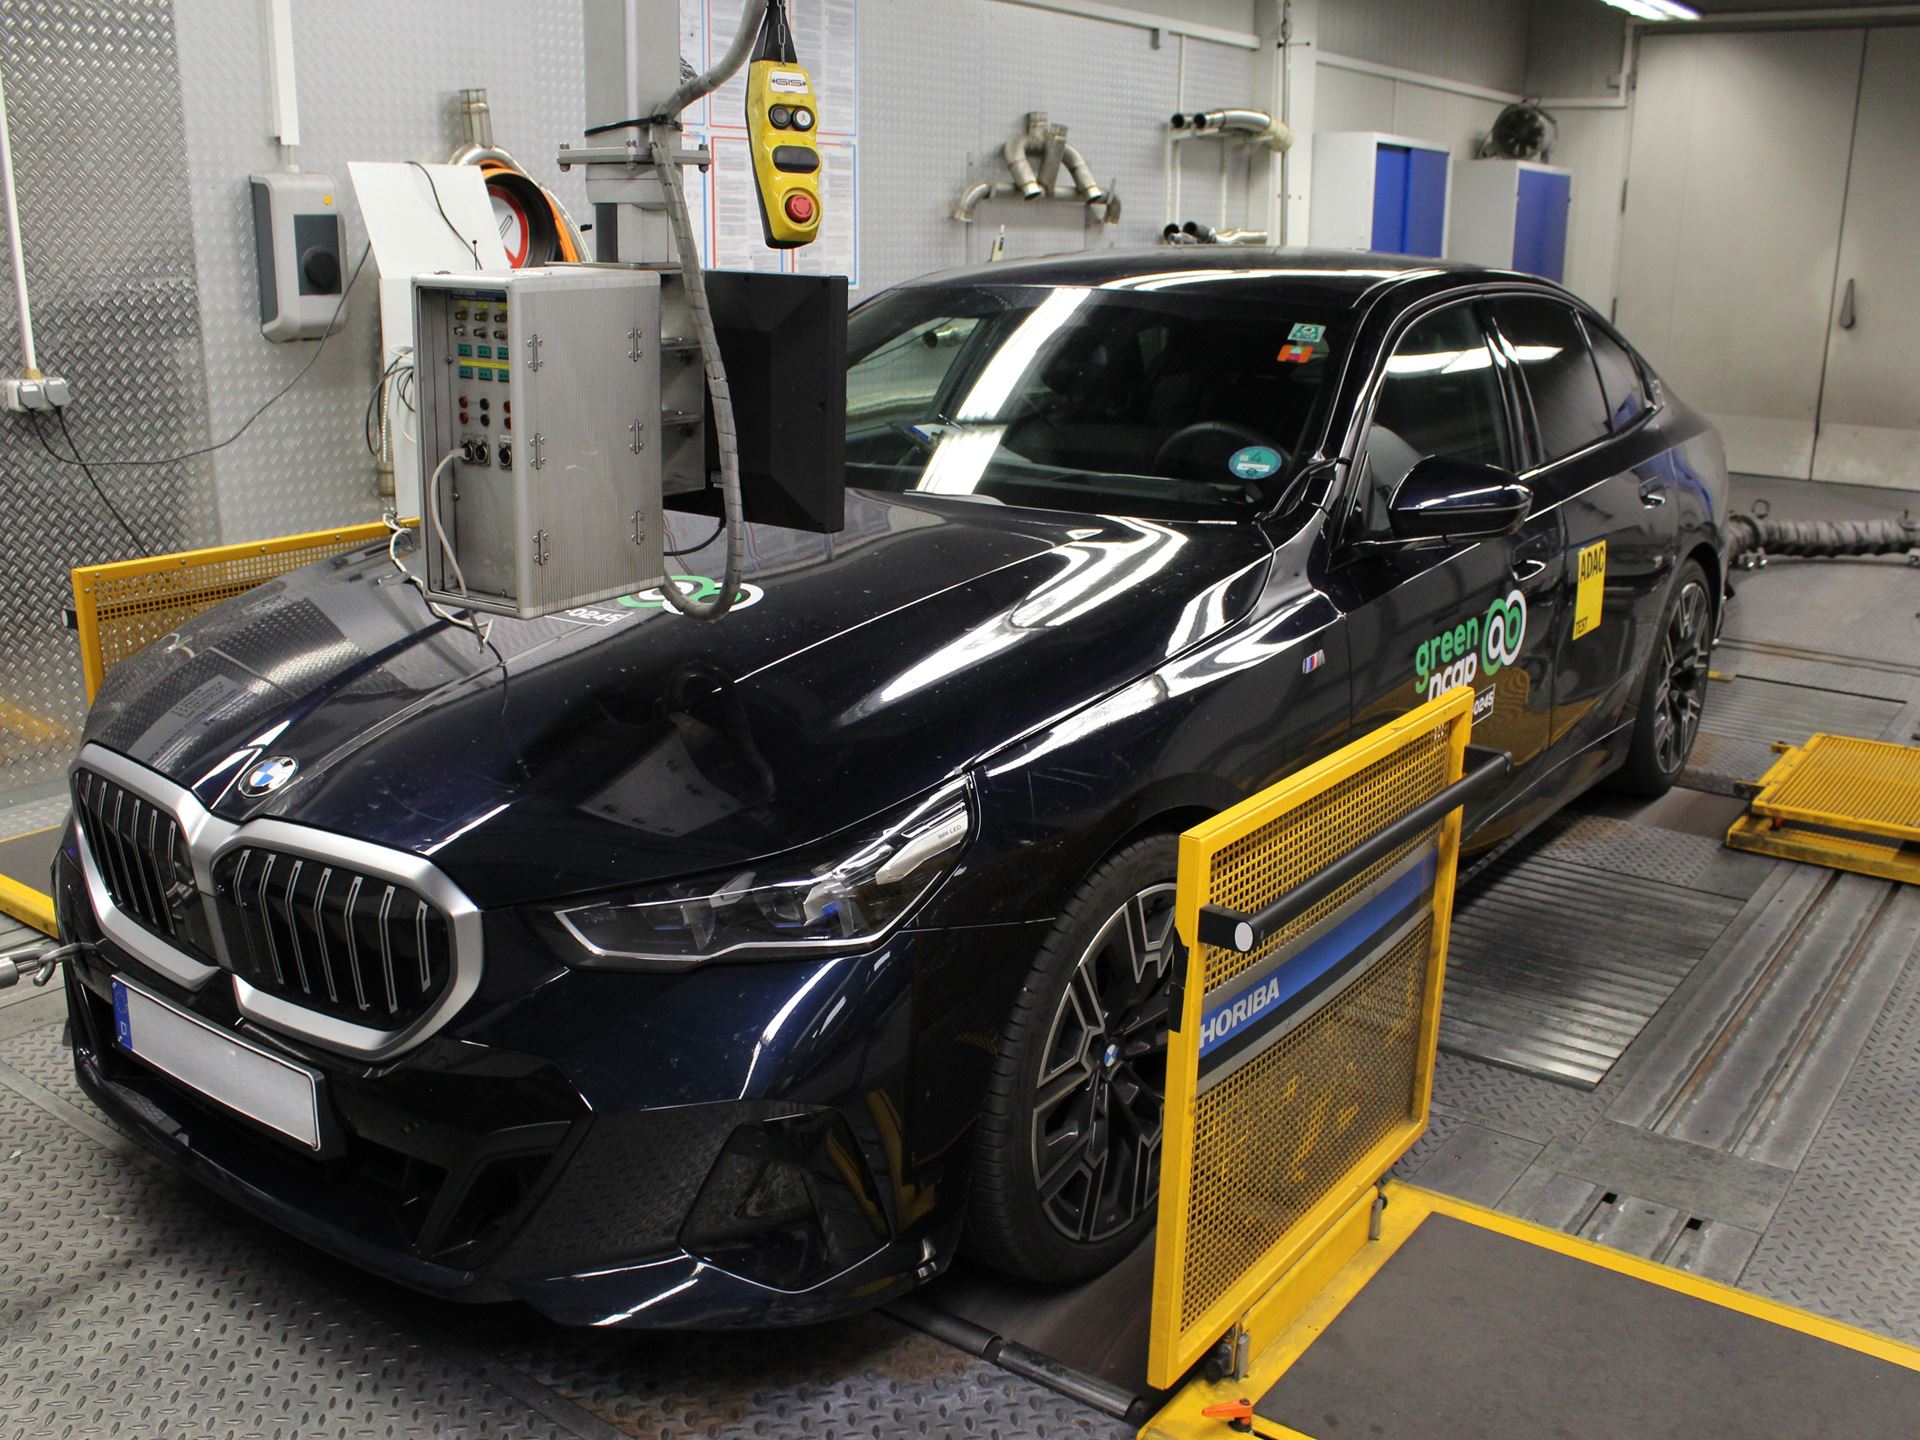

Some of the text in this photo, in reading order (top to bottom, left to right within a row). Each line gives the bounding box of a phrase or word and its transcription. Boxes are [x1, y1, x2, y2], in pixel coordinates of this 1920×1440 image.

[1580, 546, 1605, 583] ADAC
[1575, 616, 1588, 636] TEST
[1415, 617, 1479, 694] green
[1199, 976, 1280, 1049] HORIBA
